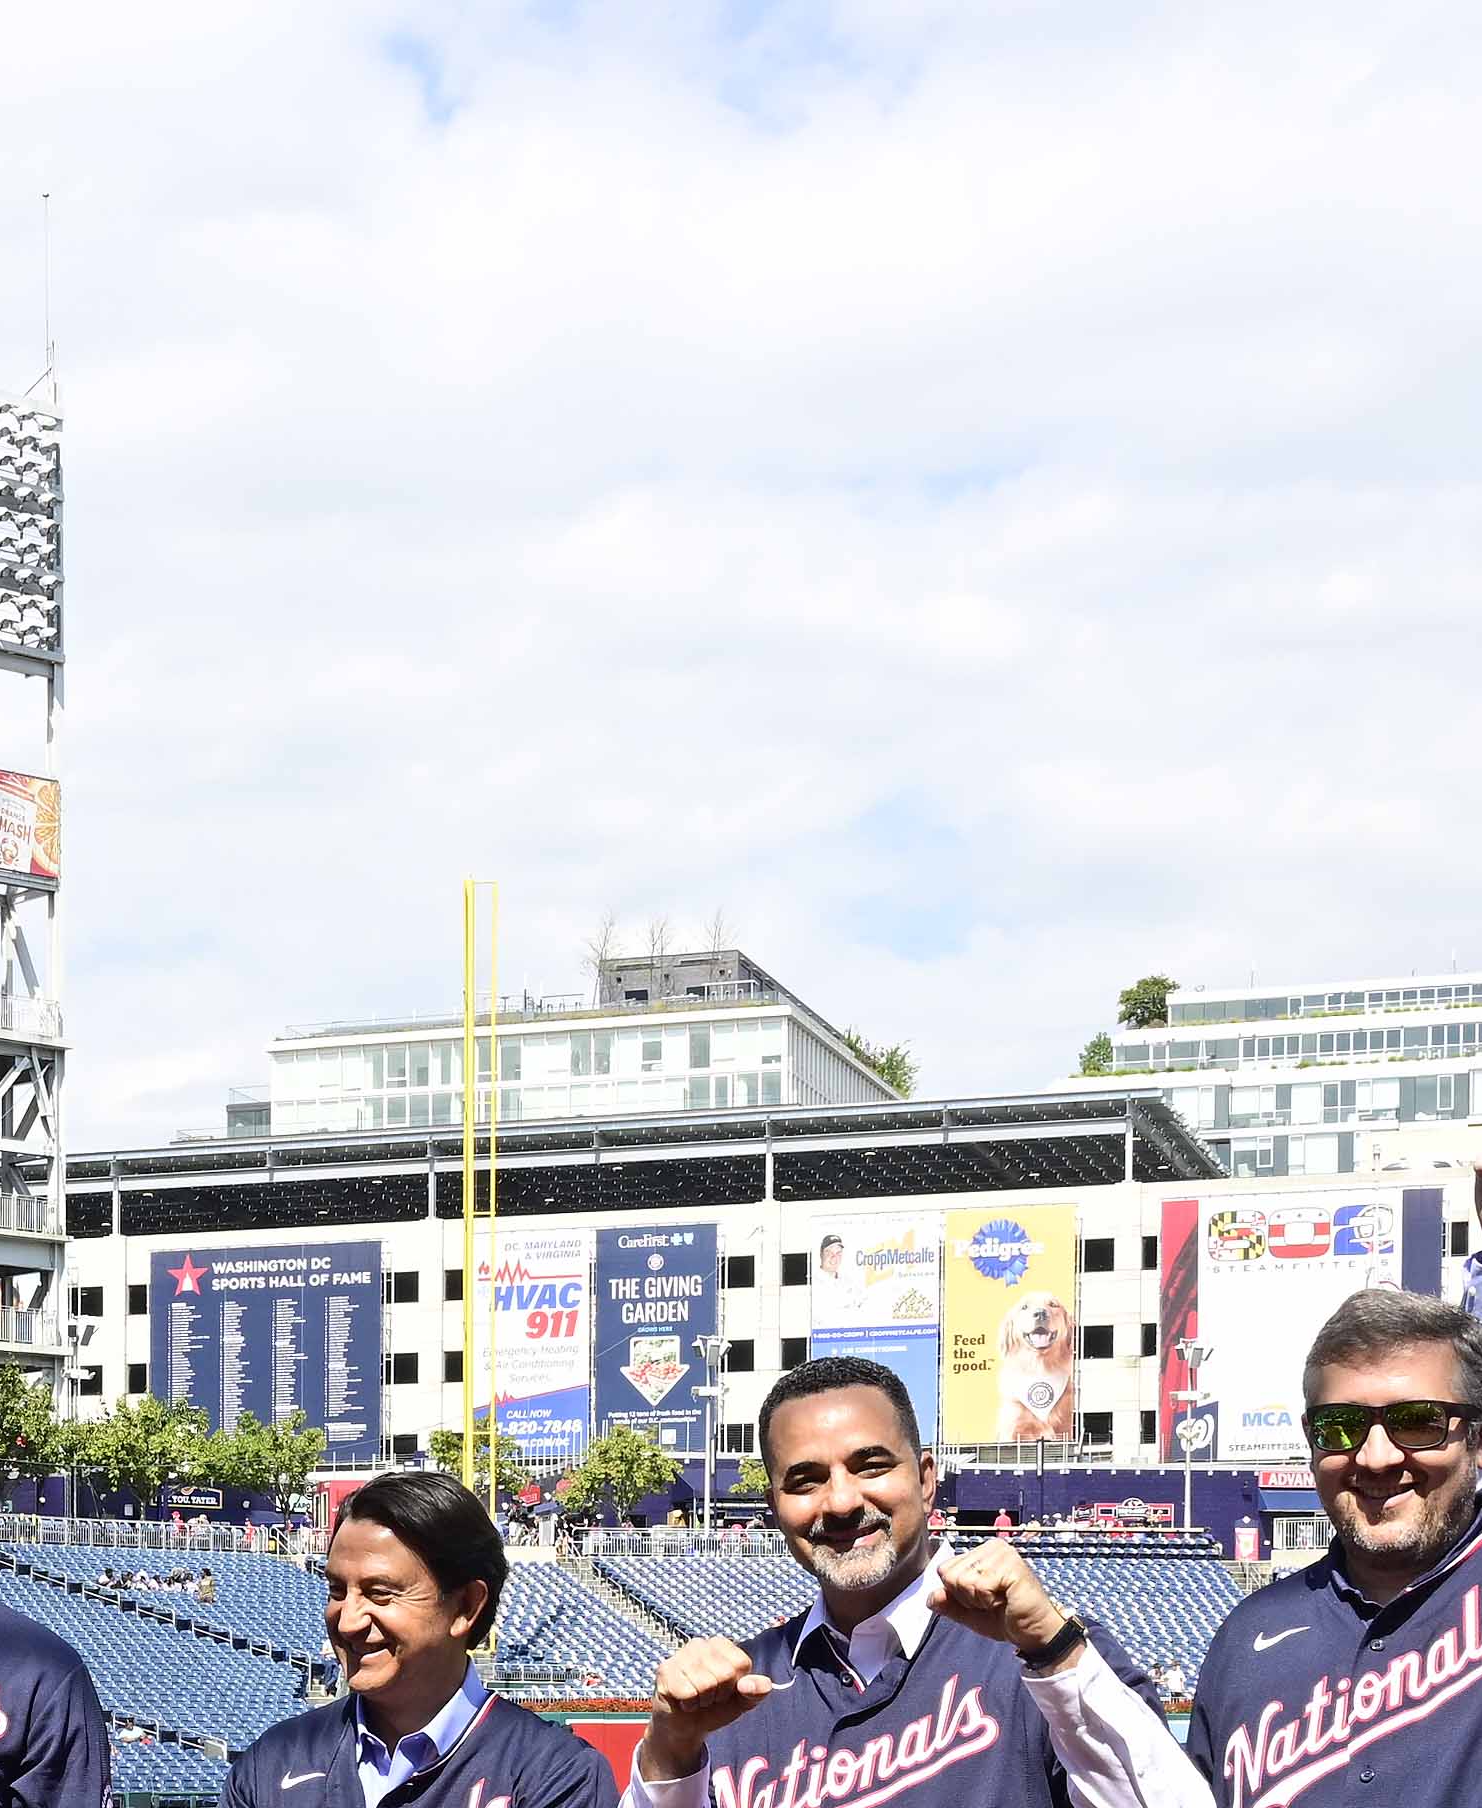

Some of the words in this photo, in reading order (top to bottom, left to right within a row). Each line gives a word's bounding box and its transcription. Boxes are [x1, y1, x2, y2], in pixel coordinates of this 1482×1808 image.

[211, 1258, 308, 1275] WASHINGTON
[310, 1257, 332, 1271] DC
[855, 1247, 935, 1271] CroppMetcalfe
[211, 1276, 266, 1291] SPORTS
[268, 1273, 306, 1289] HALL
[309, 1273, 330, 1287] OF
[332, 1271, 372, 1285] FAME
[608, 1278, 641, 1300] THE
[644, 1275, 703, 1299] GIVING
[494, 1282, 583, 1312] HVAC
[621, 1300, 689, 1325] GARDEN
[525, 1310, 579, 1339] 911
[954, 1334, 985, 1346] Feed
[954, 1348, 976, 1360] the
[506, 1410, 527, 1419] CALL
[529, 1409, 553, 1418] NOW
[1242, 1412, 1293, 1427] MCA
[1268, 1472, 1316, 1487] ADVAN
